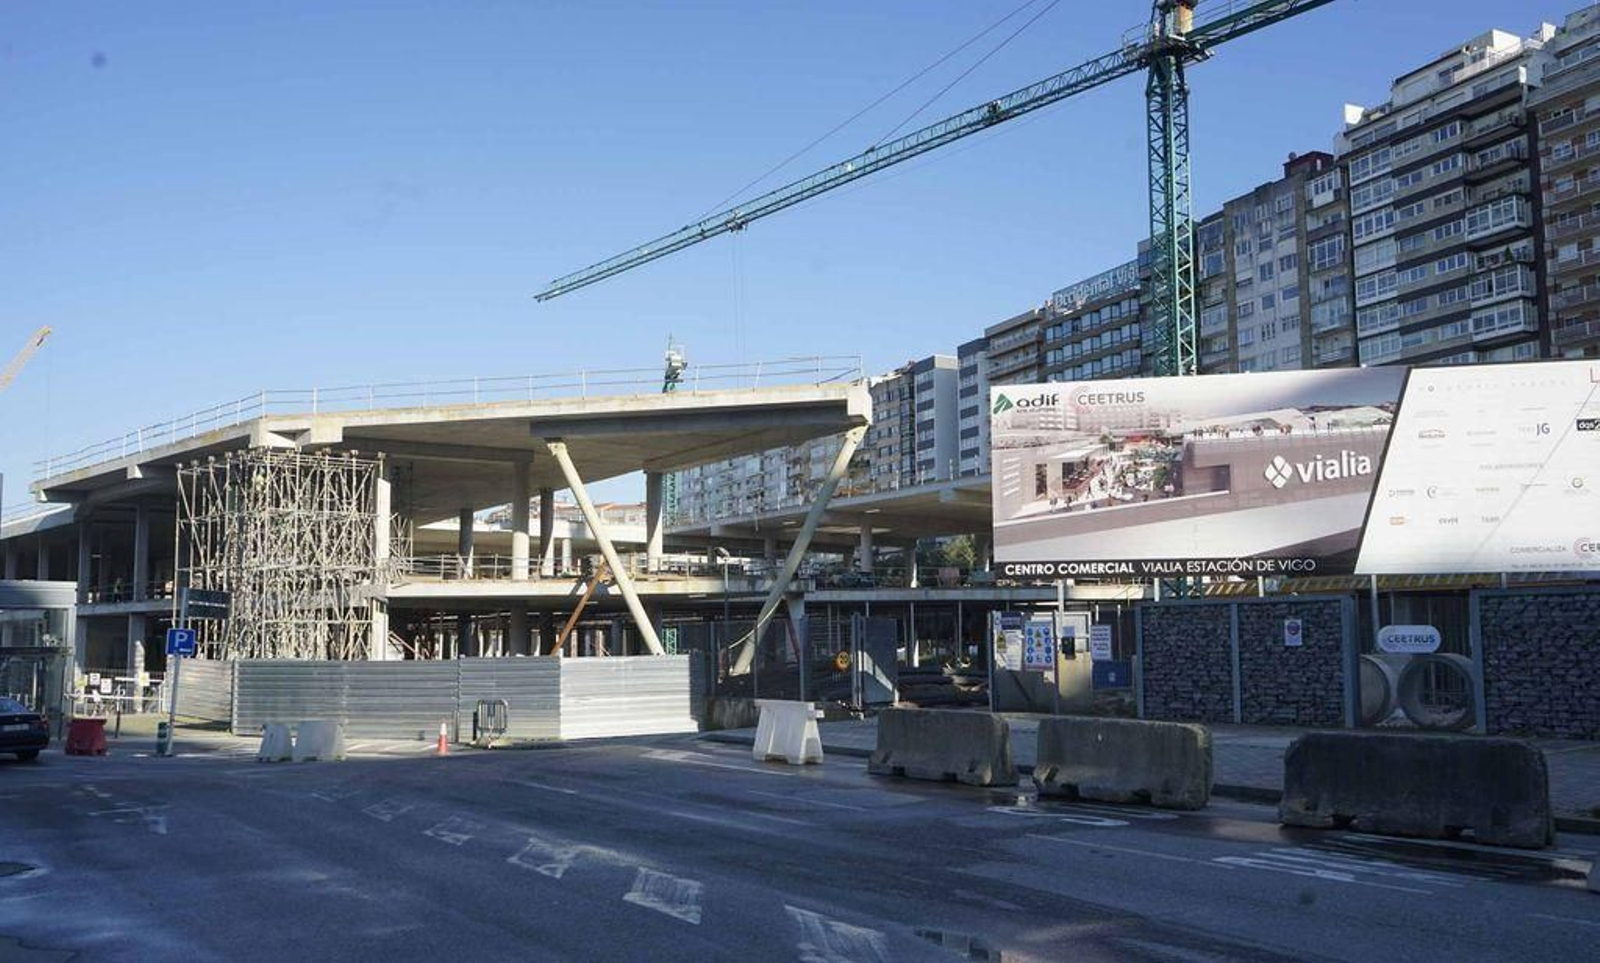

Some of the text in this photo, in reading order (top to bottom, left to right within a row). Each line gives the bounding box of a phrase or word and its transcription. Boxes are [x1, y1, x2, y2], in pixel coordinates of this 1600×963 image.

[1016, 393, 1060, 407] adif
[1077, 391, 1145, 406] CEETRUS
[1295, 449, 1371, 483] vialia
[1004, 557, 1316, 576] CENTRO COMERCIAL VIALIA ESTACIÓN DE VIGO
[175, 631, 188, 647] P
[1387, 633, 1436, 644] CEETRUS
